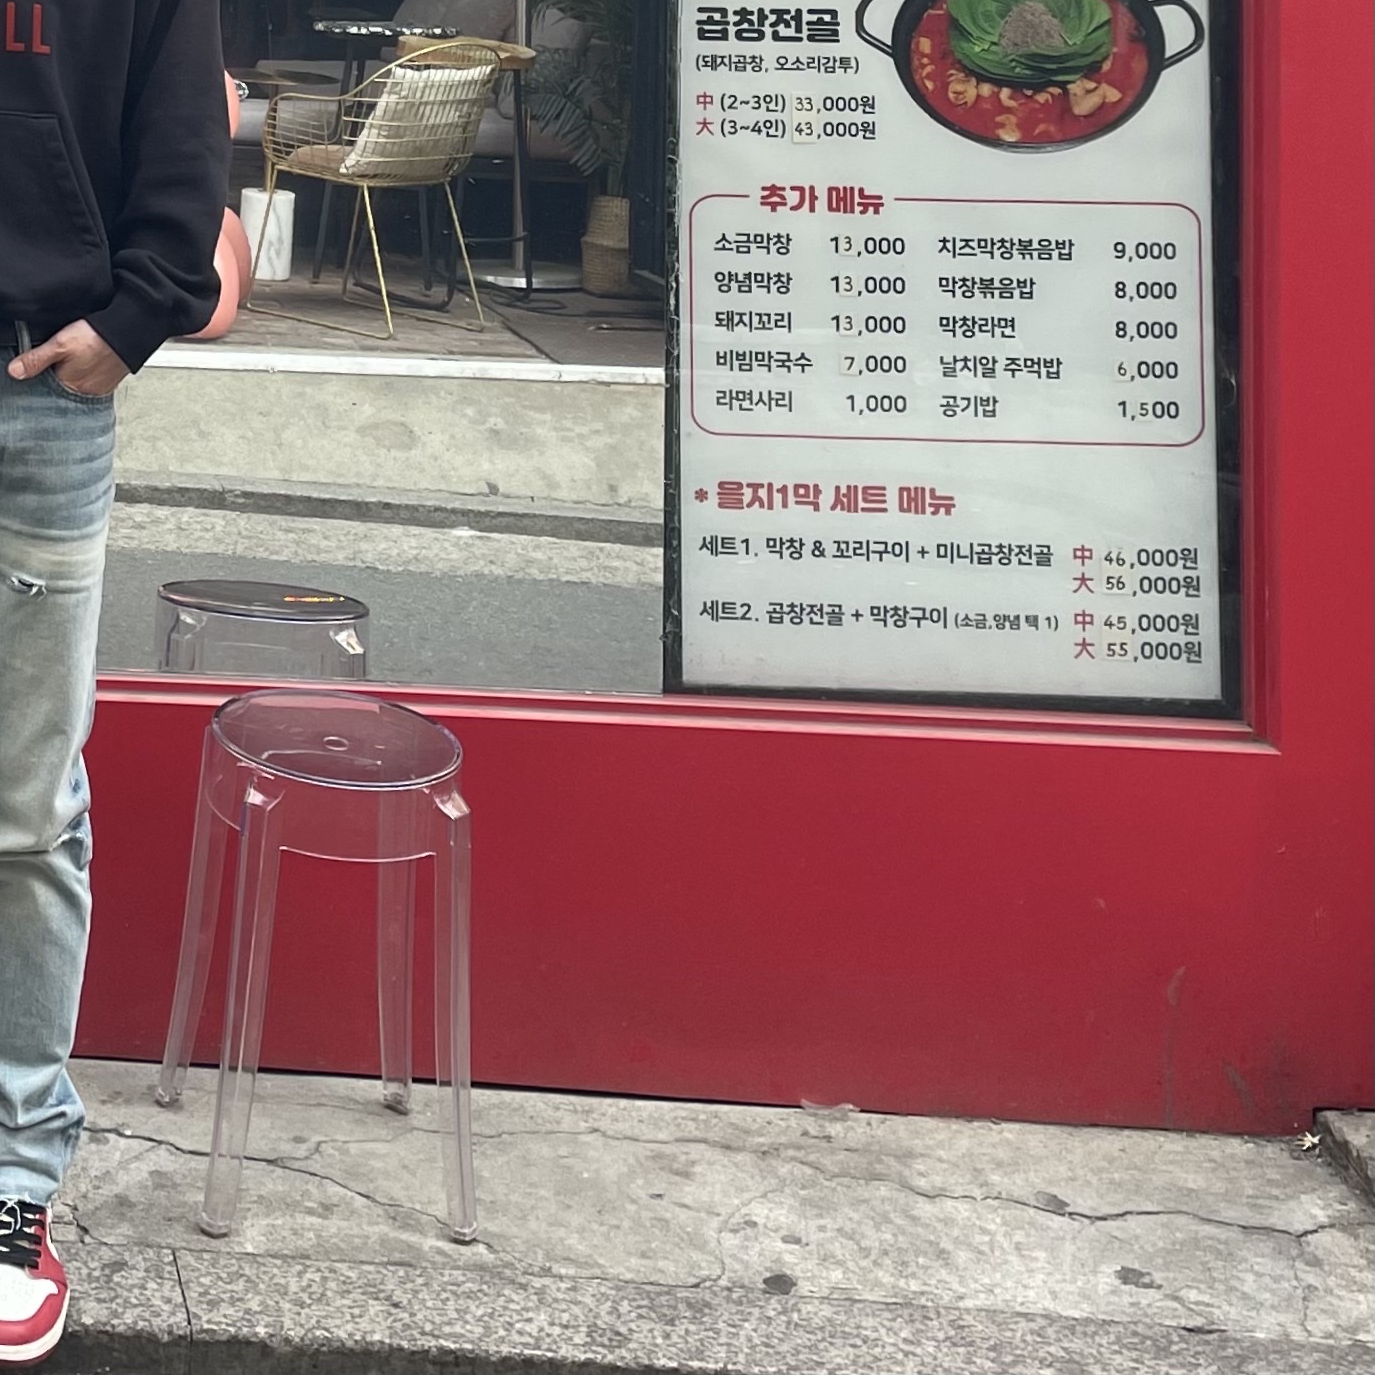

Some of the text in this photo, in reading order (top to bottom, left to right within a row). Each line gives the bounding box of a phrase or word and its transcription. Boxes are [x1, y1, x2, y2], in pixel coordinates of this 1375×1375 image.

[696, 7, 840, 43] 곱창전골
[696, 54, 859, 74] (돼지곱창, 오소리감투)
[696, 91, 713, 111] 中
[720, 93, 786, 113] (2~3인)
[696, 117, 714, 136] 大
[720, 118, 786, 138] (3~4인)
[760, 184, 884, 214] 추가 메뉴
[713, 232, 905, 257] 소금막창 13,000
[938, 237, 1176, 262] 치즈막창볶음밥 9,000
[714, 271, 906, 297] 양념막창 13,000
[938, 276, 1177, 302] 막창볶음밥 8,000
[714, 310, 906, 336] 돼지꼬리 13,000
[939, 315, 1178, 342] 막창라면 8,000
[716, 349, 907, 376] 비빔막국수 7,000
[940, 354, 1179, 382] 날치알 주먹밥 6,000
[716, 389, 907, 415] 라면사리 1,000
[939, 395, 1180, 421] 공기밥 1,500
[717, 480, 956, 516] 을지1막 세트 메뉴
[699, 535, 1198, 570] 세트1. 막창 & 꼬리구이 + 미니곱창전골 中 46,000원
[1072, 572, 1201, 598] 大 56,000원
[699, 600, 759, 622] 세트2.
[766, 602, 845, 626] 곱창전골
[851, 609, 864, 622] +
[870, 605, 948, 629] 막창구이
[1073, 610, 1094, 632] 中
[1103, 613, 1199, 636] 45,000원
[1074, 637, 1202, 663] 大 55,000원
